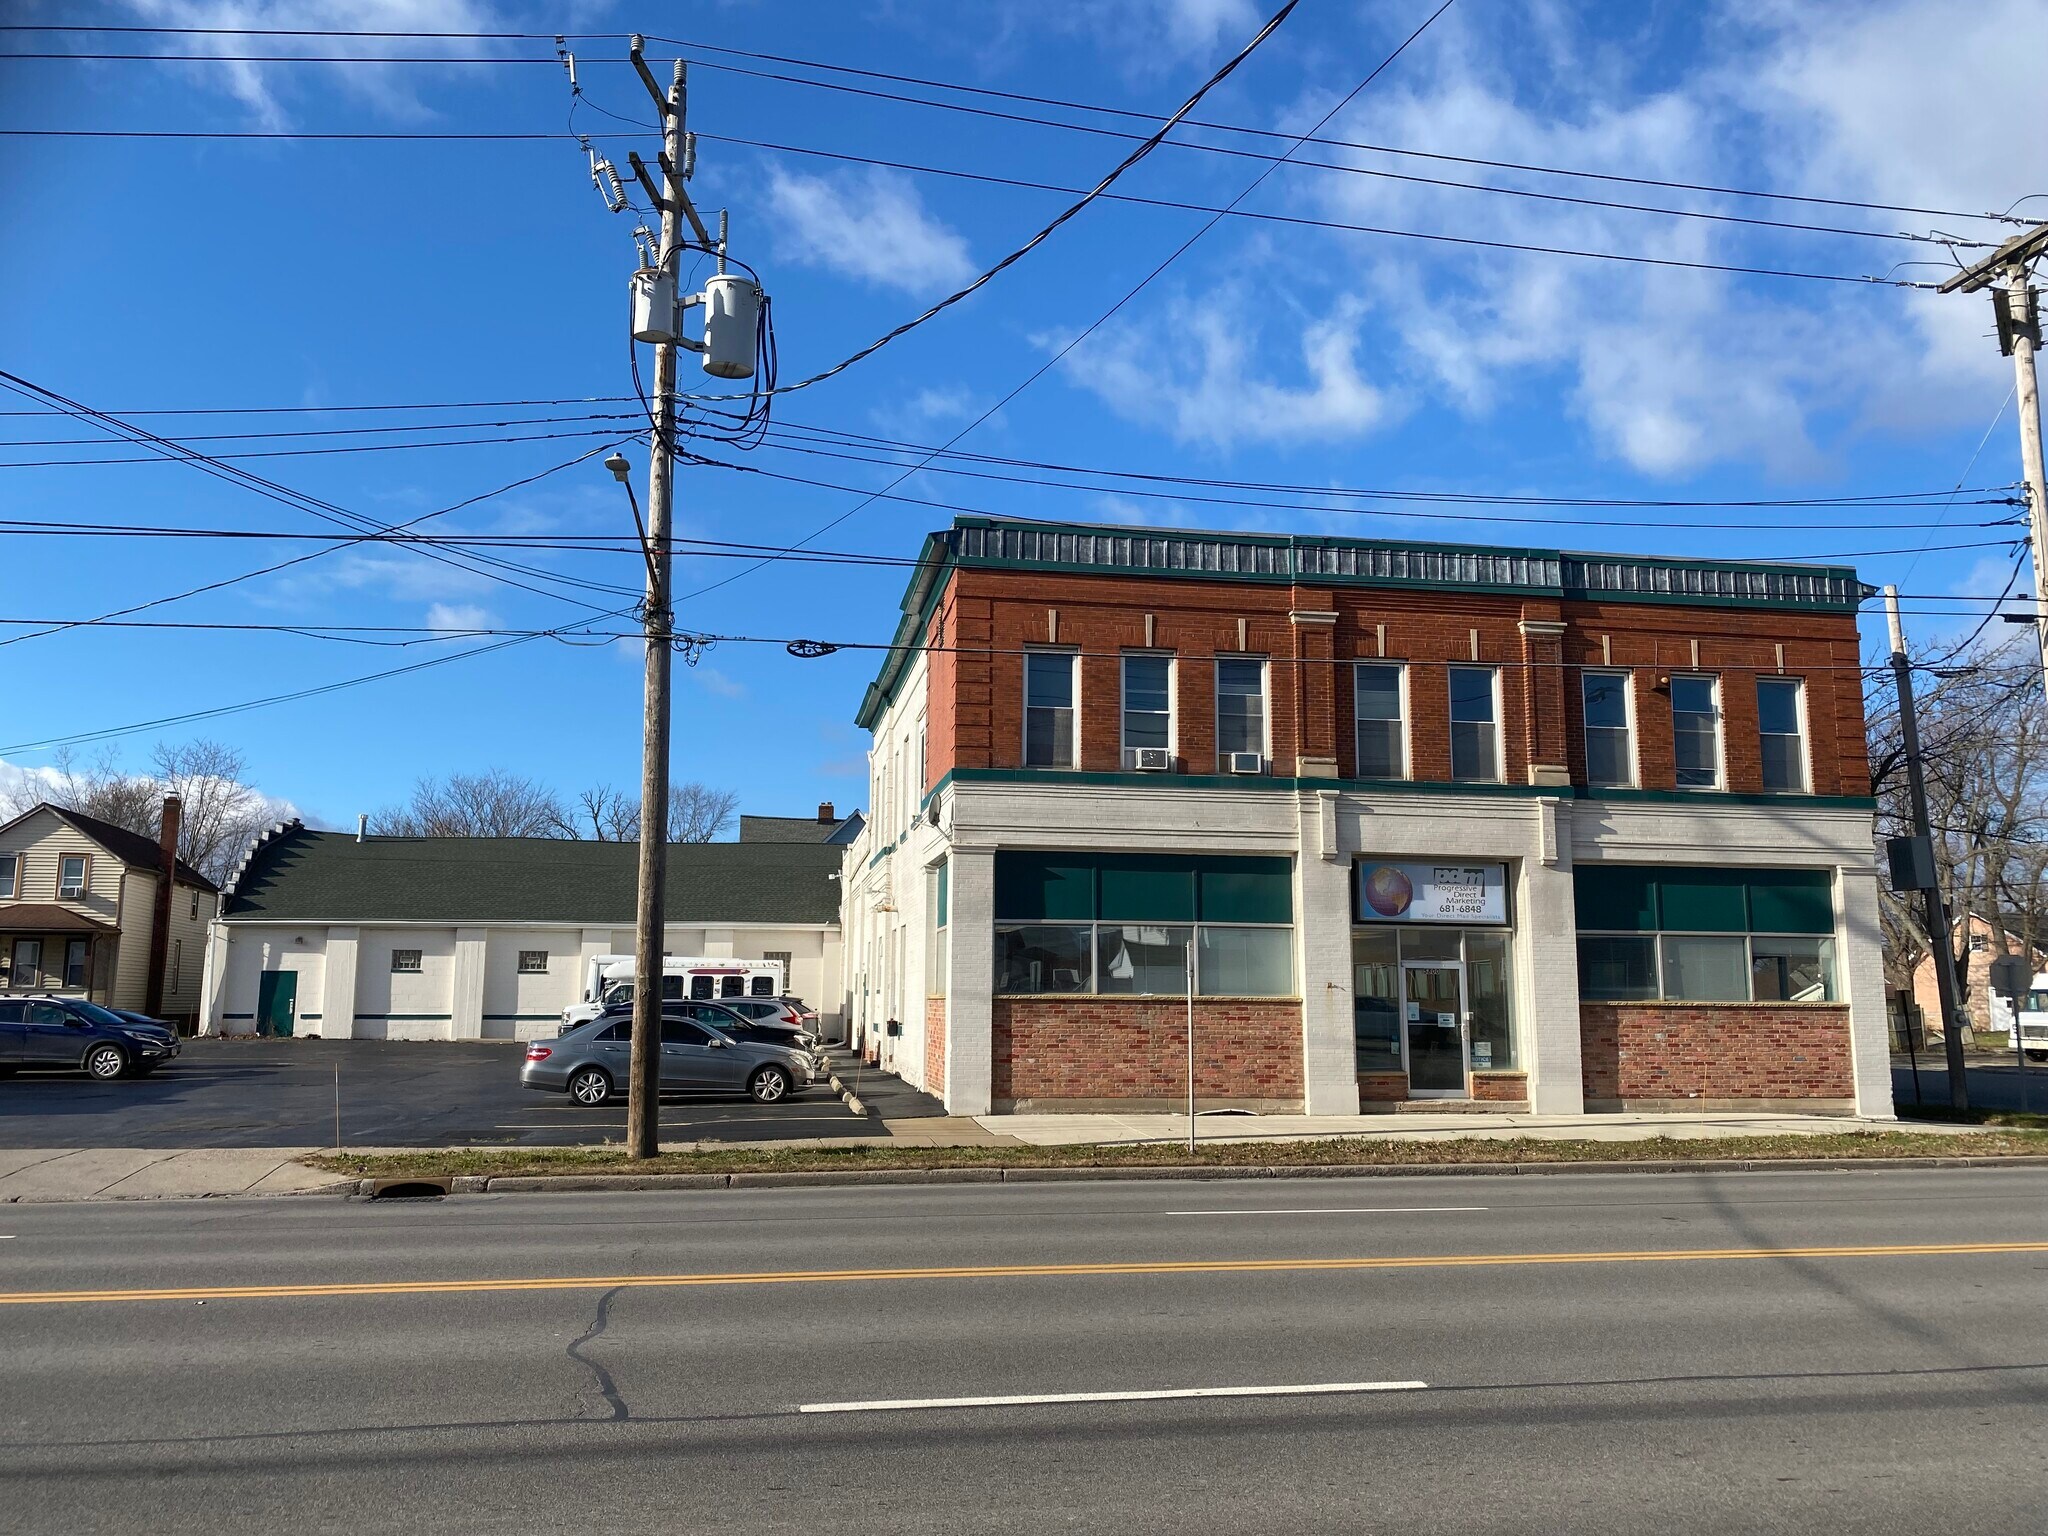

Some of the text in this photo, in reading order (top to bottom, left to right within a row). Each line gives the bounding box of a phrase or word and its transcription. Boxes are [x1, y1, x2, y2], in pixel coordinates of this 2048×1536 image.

[1434, 884, 1477, 893] Progressive
[1446, 897, 1486, 906] Marketing
[1439, 905, 1482, 913] 681-6848
